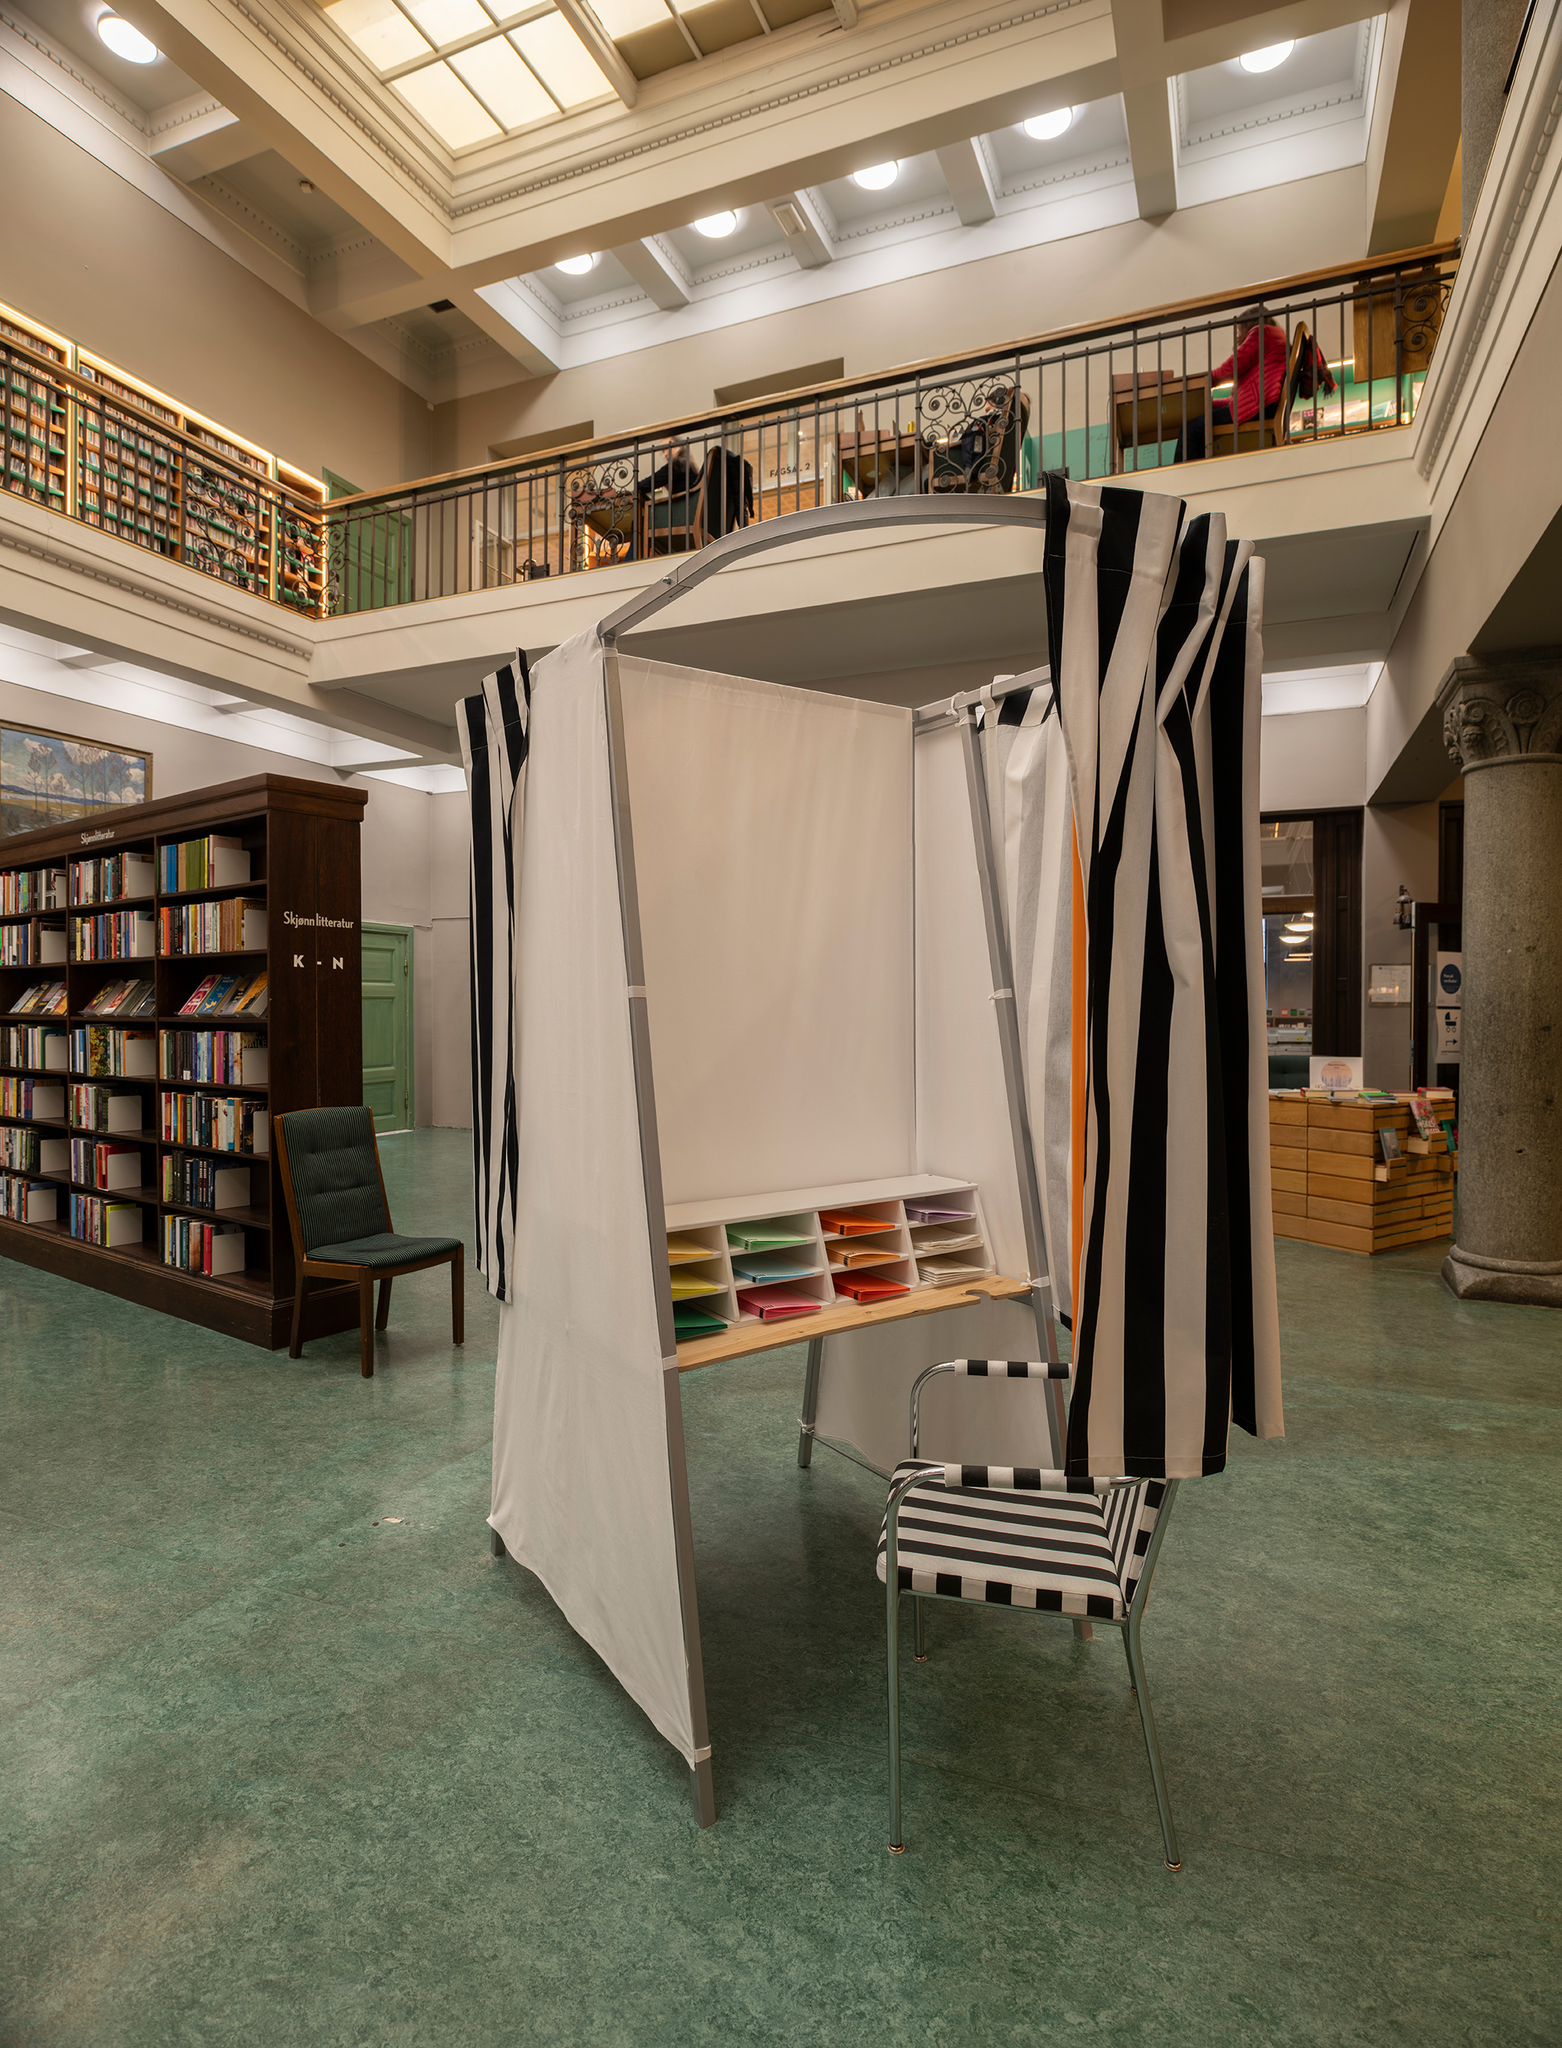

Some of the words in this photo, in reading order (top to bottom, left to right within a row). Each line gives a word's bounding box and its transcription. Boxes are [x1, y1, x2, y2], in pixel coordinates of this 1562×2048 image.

[805, 462, 811, 471] 2
[293, 954, 305, 968] K
[332, 957, 344, 970] N
